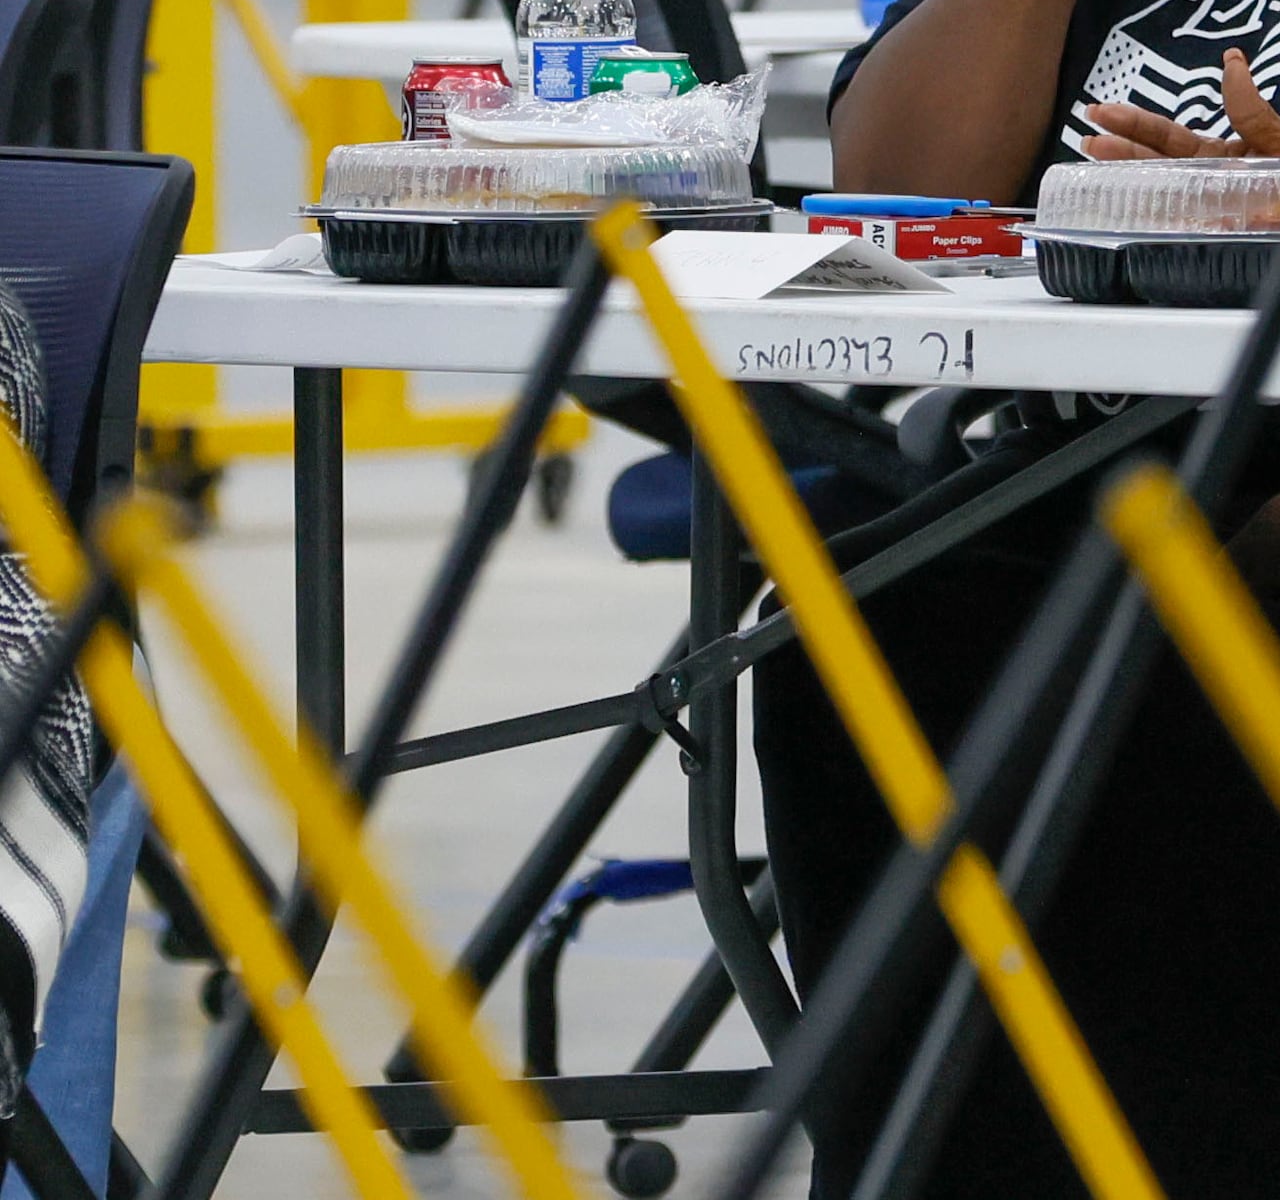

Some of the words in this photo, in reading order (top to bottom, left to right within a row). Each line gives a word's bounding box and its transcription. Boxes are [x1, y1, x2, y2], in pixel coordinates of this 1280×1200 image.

[872, 224, 885, 249] AC
[933, 236, 958, 246] Paper
[960, 236, 983, 246] Clips
[737, 336, 893, 376] ELECTIONS
